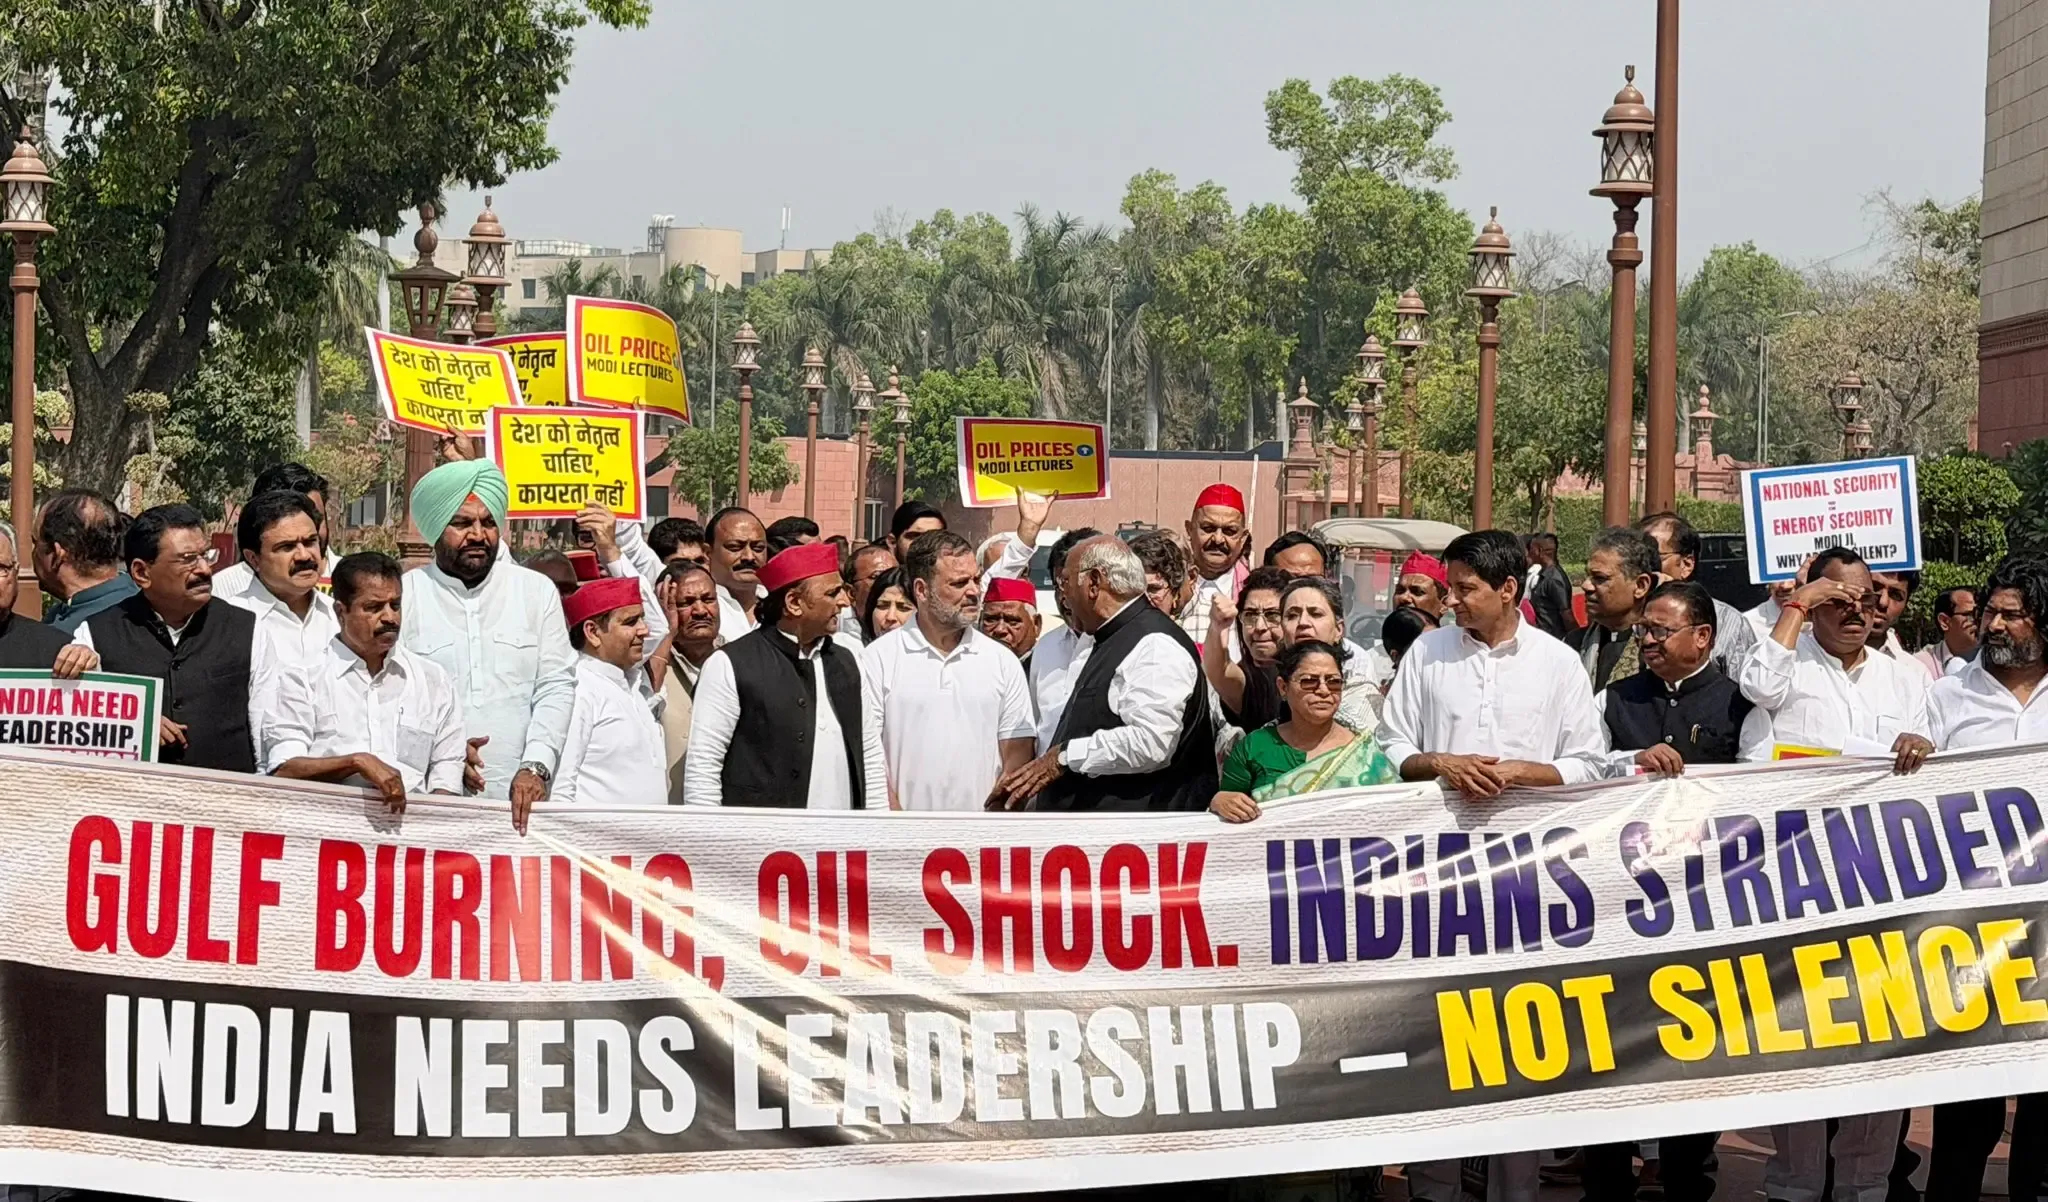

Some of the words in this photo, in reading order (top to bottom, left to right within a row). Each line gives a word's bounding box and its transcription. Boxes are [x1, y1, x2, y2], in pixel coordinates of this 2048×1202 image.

[389, 342, 417, 369] देश
[419, 351, 441, 374] को
[444, 354, 492, 384] नेतृत्व
[517, 344, 557, 378] नेतृत्व
[585, 333, 614, 354] OIL
[620, 336, 672, 366] PRICES
[587, 356, 618, 373] MODI
[622, 361, 674, 383] LECTURES
[417, 377, 472, 404] चाहिए,
[402, 397, 464, 426] कायरता
[510, 417, 542, 443] देश
[545, 417, 570, 443] को
[574, 417, 621, 455] नेतृत्व
[976, 442, 1006, 459] OIL
[1010, 442, 1075, 458] PRICES
[541, 447, 599, 477] चाहिए,
[978, 461, 1011, 475] MODI
[1014, 459, 1073, 473] LECTURES
[516, 483, 589, 504] कायरता
[592, 479, 628, 506] नहीं
[1762, 478, 1830, 501] NATIONAL
[1833, 472, 1898, 495] SECURITY
[1773, 514, 1825, 536] ENERGY
[1829, 508, 1893, 529] SECURITY
[1814, 534, 1842, 550] MODI
[1776, 553, 1803, 568] WHY
[0, 688, 64, 716] NDIA
[71, 689, 139, 720] NEED
[0, 719, 138, 752] EADERSHIP,
[66, 815, 285, 966] GULF
[315, 839, 725, 993] BURNING,
[757, 850, 892, 977] OIL
[922, 841, 1239, 976] SHOCK.
[1266, 826, 1595, 965] INDIANS
[1618, 787, 2048, 938] STRANDED
[105, 994, 357, 1135] INDIA
[393, 1015, 697, 1138] NEEDS
[733, 1000, 1301, 1132] LEADERSHIP
[1437, 974, 1615, 1091] NOT
[1648, 919, 2048, 1062] SILENCE
